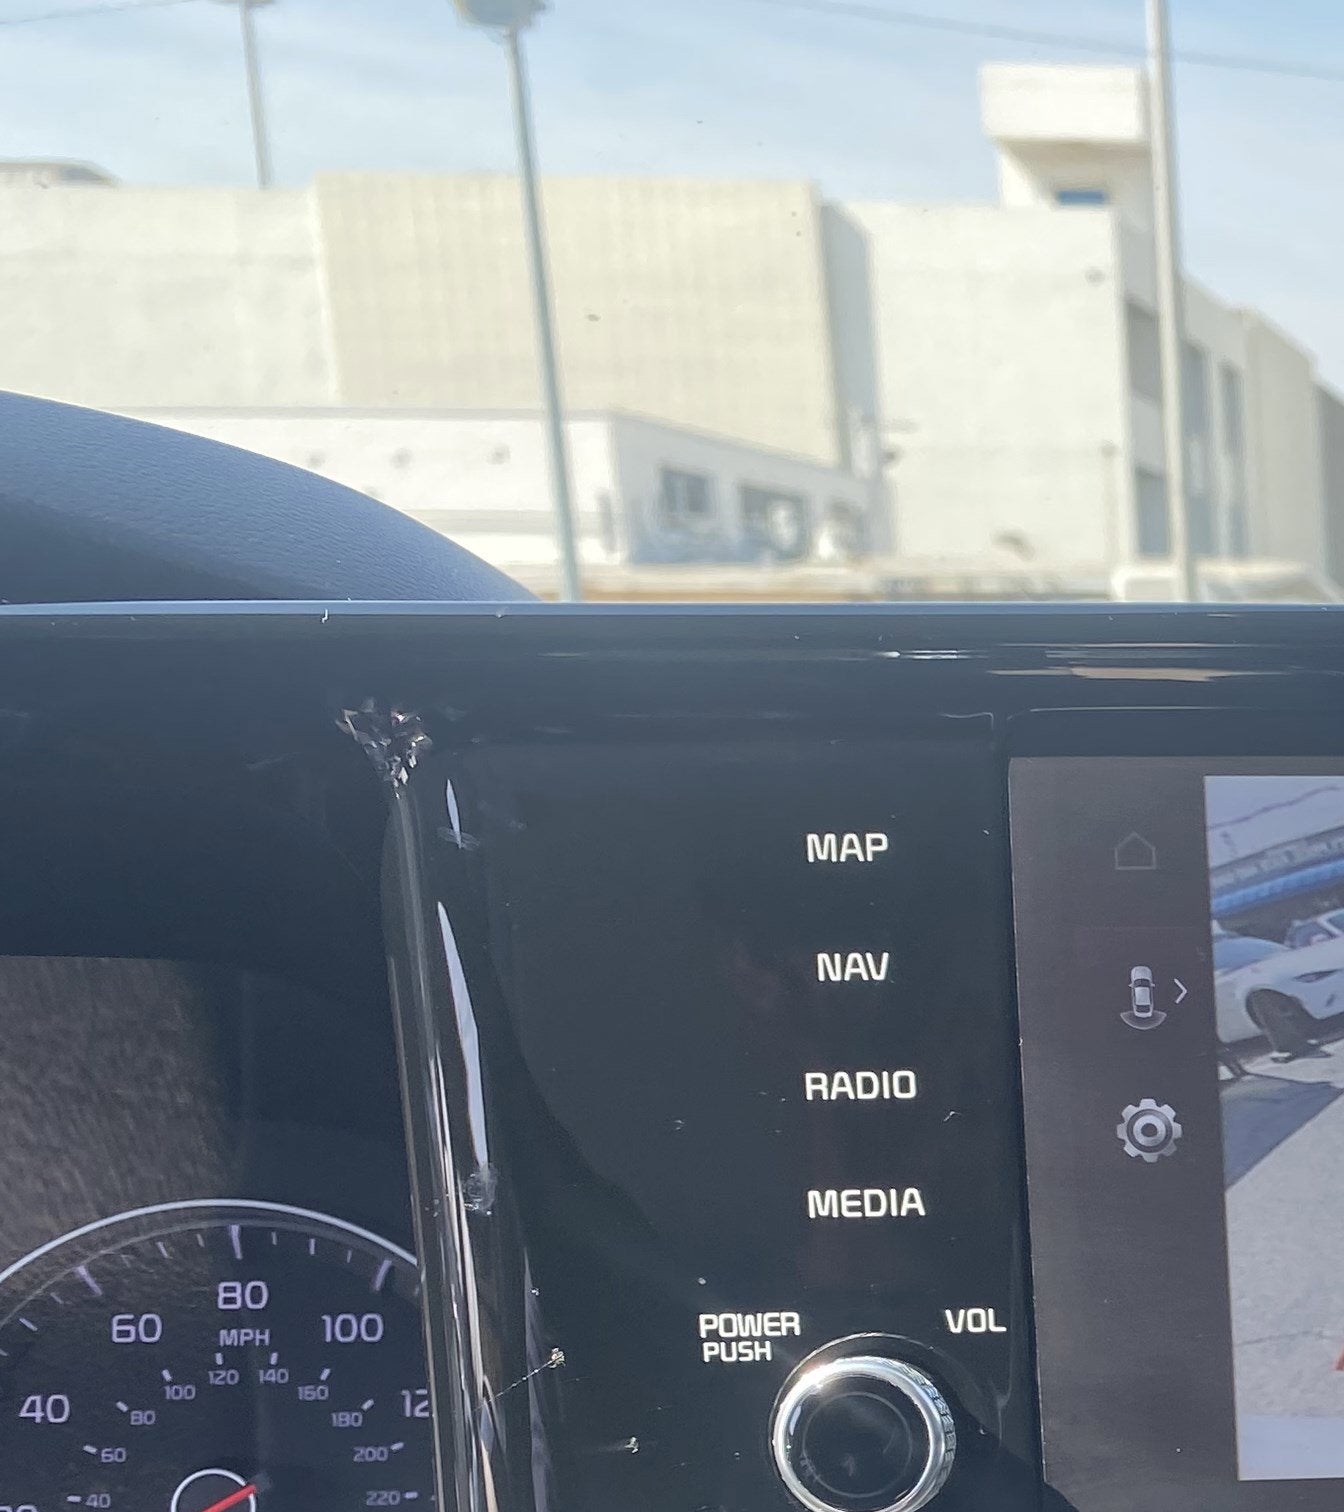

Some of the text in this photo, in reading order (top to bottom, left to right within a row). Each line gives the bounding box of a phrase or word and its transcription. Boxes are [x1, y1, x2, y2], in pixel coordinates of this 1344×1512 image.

[806, 832, 889, 863] MAP
[817, 952, 889, 982] NAV
[805, 1070, 917, 1101] RADIO
[807, 1187, 926, 1219] MEDIA
[218, 1281, 269, 1310] 80
[111, 1313, 163, 1343] 60
[321, 1313, 384, 1343] 100
[699, 1311, 801, 1338] POWER
[944, 1307, 1007, 1334] VOL
[219, 1329, 270, 1347] MPH
[702, 1340, 772, 1363] PUSH
[208, 1370, 240, 1385] 120
[258, 1368, 290, 1384] 140
[163, 1385, 196, 1400] 100
[297, 1385, 330, 1400] 160
[19, 1394, 70, 1424] 40
[129, 1411, 156, 1425] 80
[331, 1412, 363, 1427] 180
[100, 1448, 127, 1462] 60
[353, 1447, 388, 1462] 200
[85, 1493, 112, 1508] 40
[366, 1491, 400, 1505] 220
